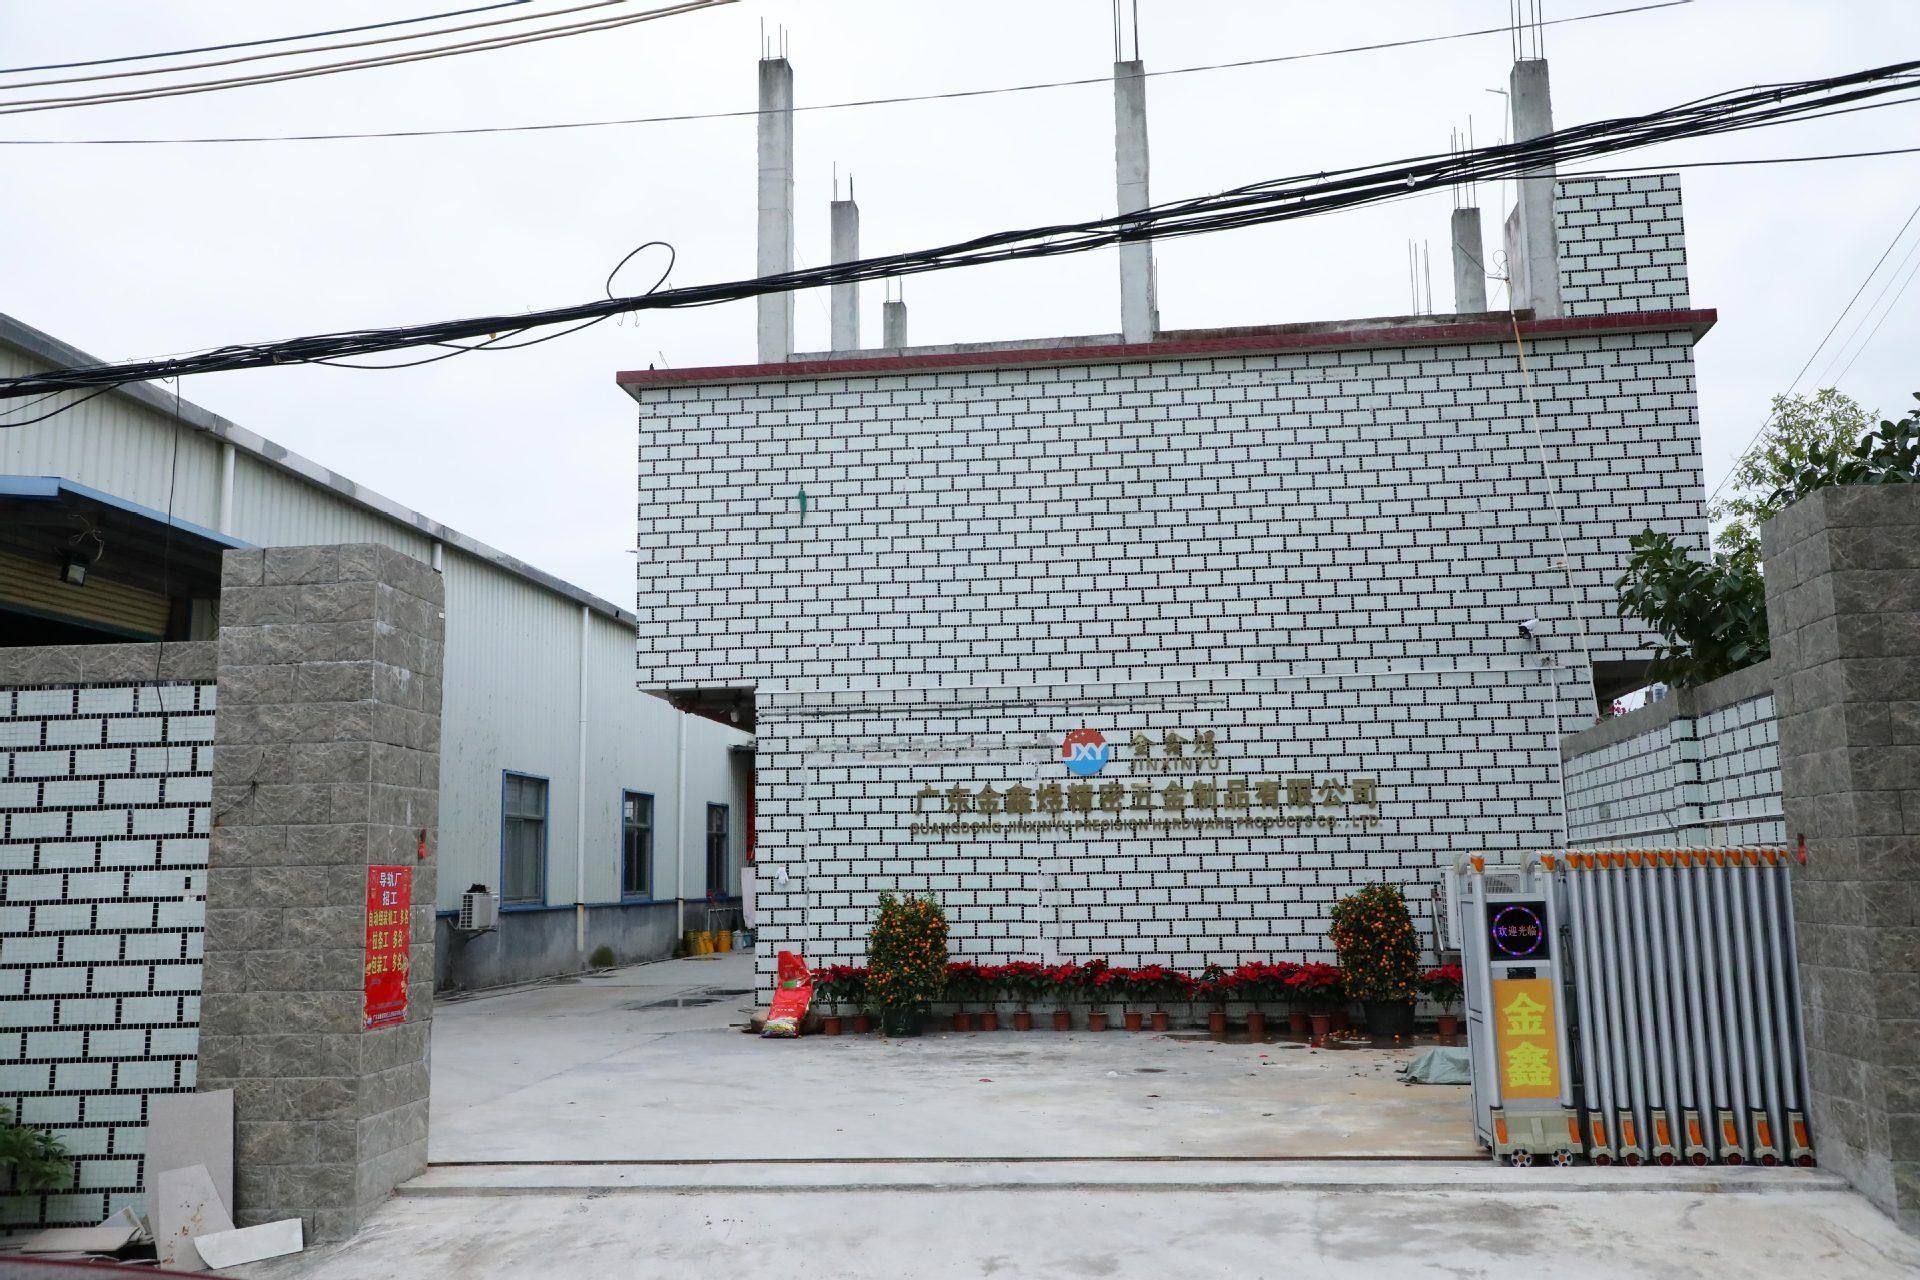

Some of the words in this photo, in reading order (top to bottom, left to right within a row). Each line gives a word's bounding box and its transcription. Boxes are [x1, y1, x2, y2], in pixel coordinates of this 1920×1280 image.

[1063, 742, 1108, 761] JXY
[1129, 757, 1219, 772] JINXINYU
[914, 777, 1378, 816] 广东金鑫煜精密五金制品有限公司
[910, 821, 1002, 836] GUANGDONG
[1004, 819, 1070, 834] JINXINYU
[1075, 817, 1149, 832] PRECISION
[1152, 816, 1232, 832] HARDWARE
[1236, 815, 1313, 830] PRODUCTS
[379, 871, 402, 887] 导轨厂
[382, 891, 398, 906] 招工
[1497, 925, 1537, 937] 欢迎光临
[1503, 992, 1552, 1088] 金鑫
